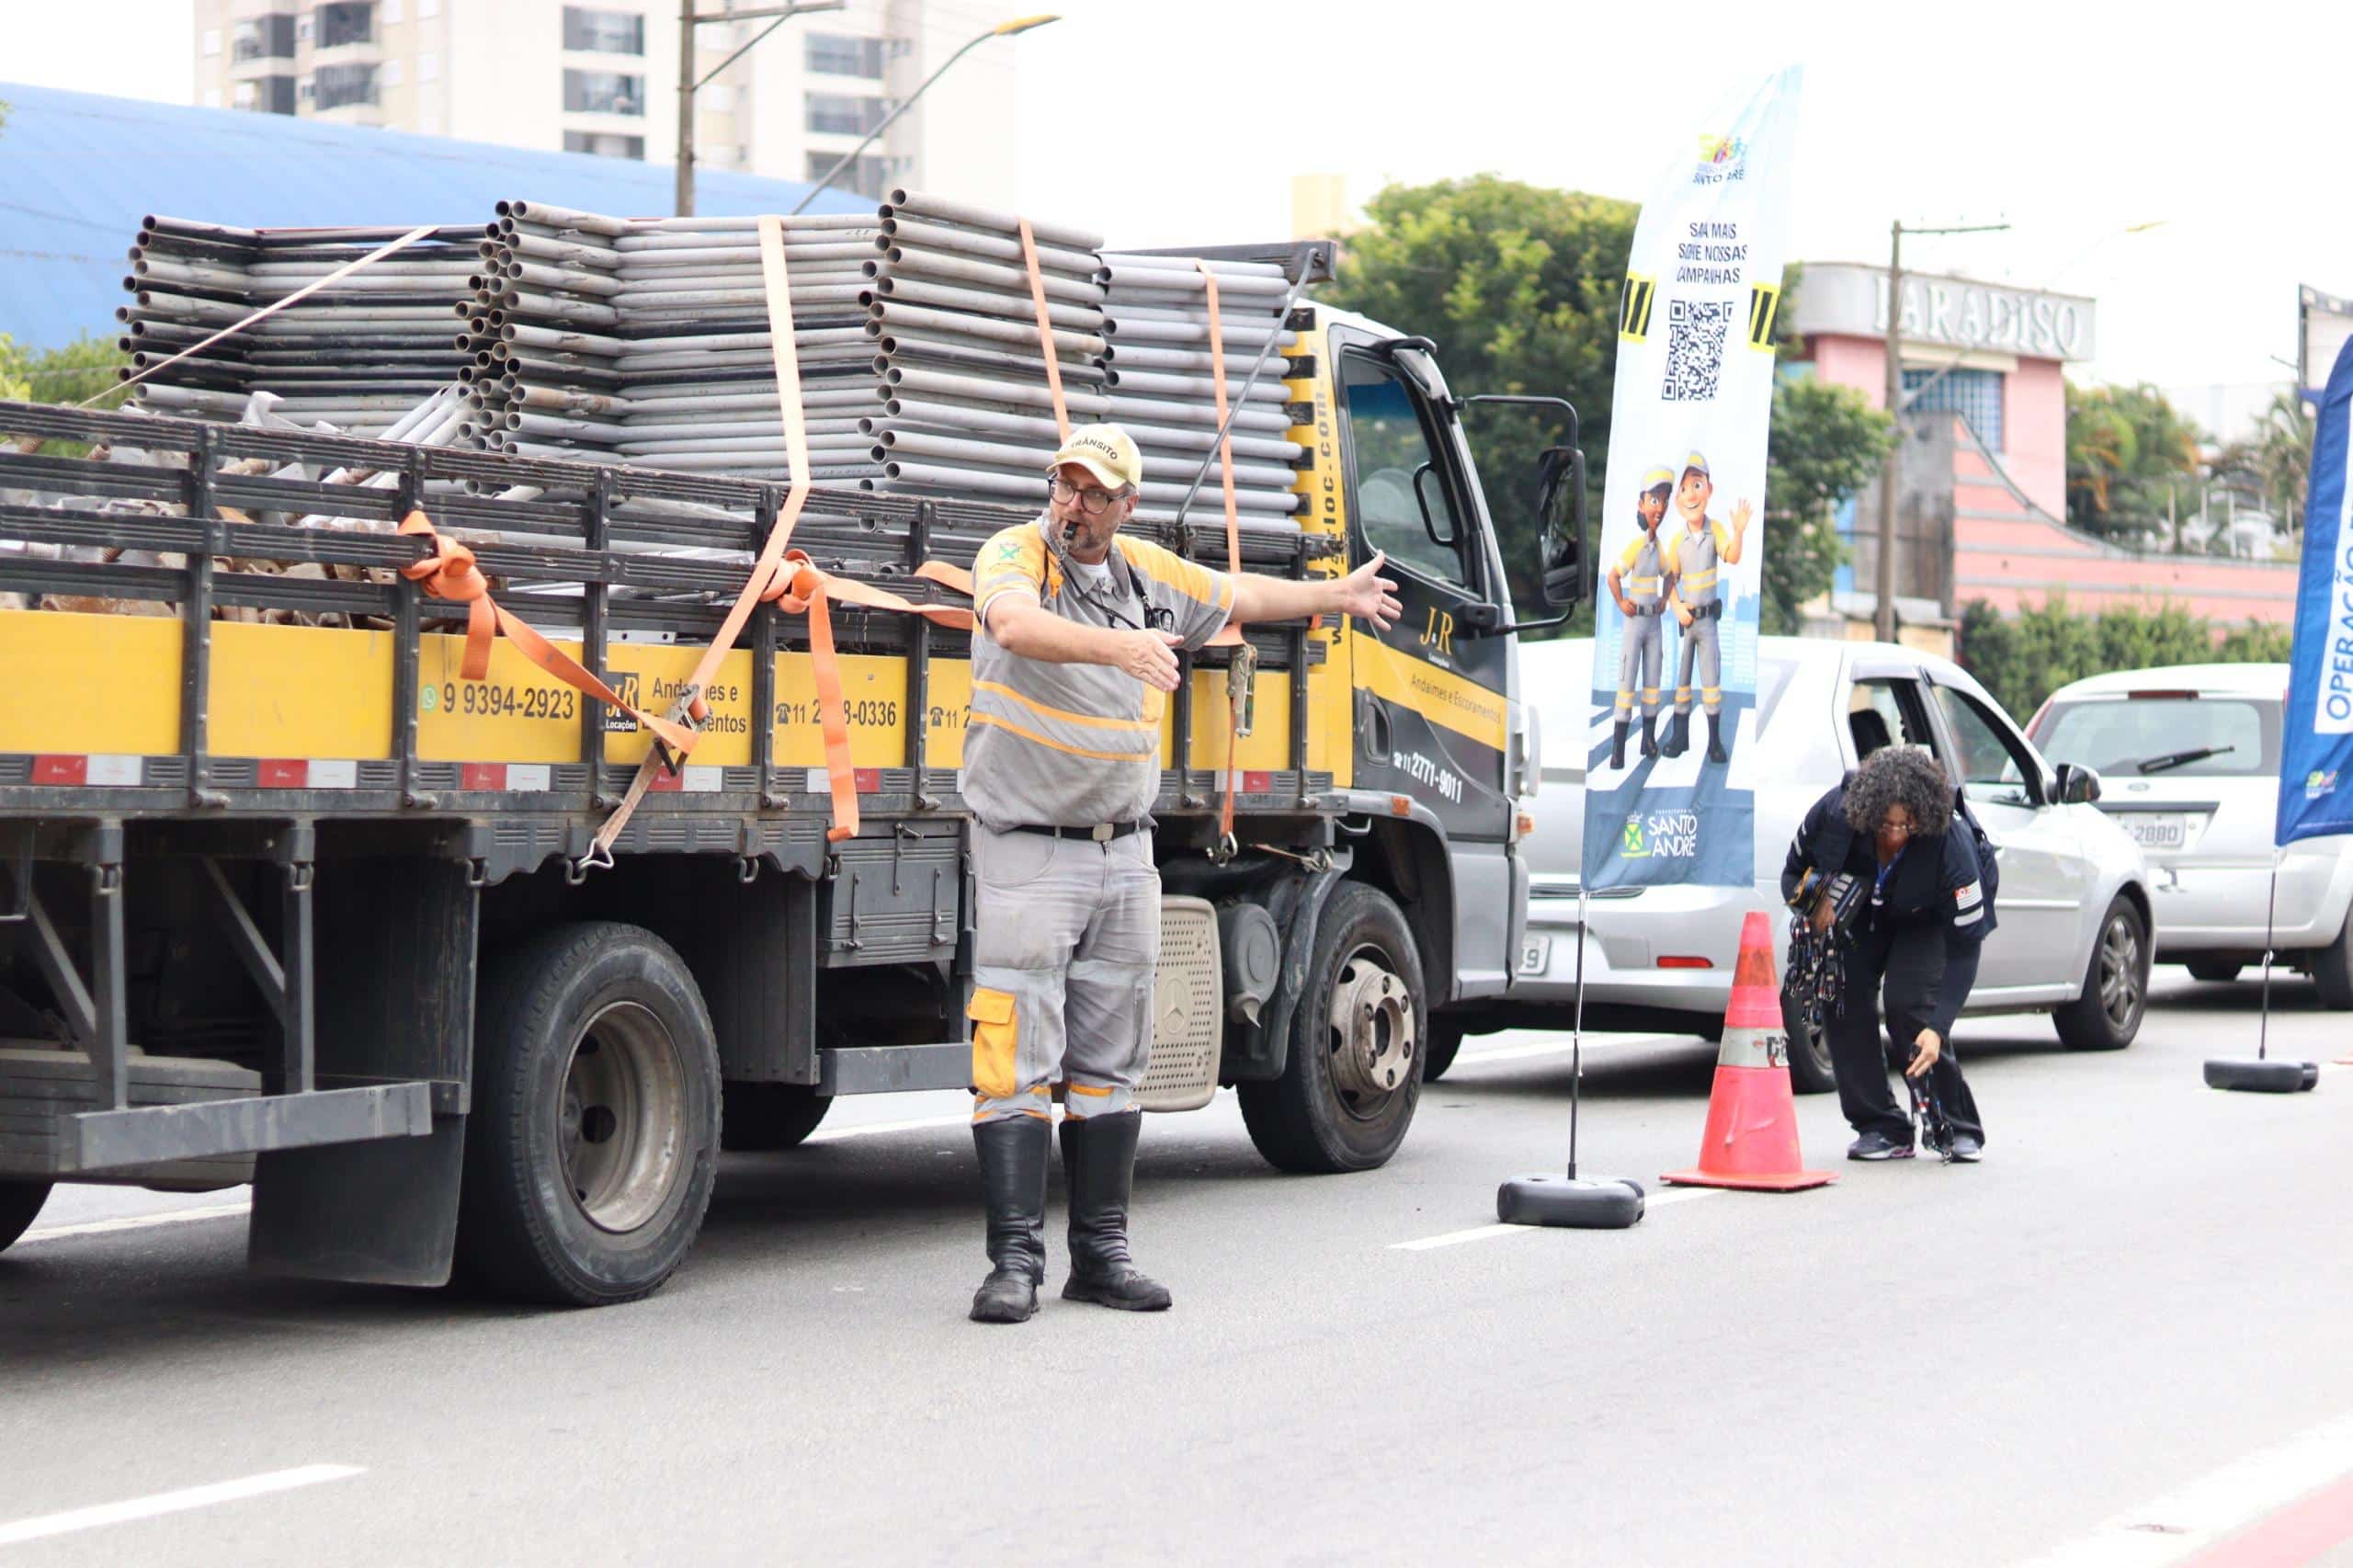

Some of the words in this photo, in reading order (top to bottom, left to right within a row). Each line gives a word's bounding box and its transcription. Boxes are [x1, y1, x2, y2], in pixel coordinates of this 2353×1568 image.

[653, 676, 726, 701] Andes
[730, 687, 738, 701] e
[443, 682, 456, 713] 9
[463, 683, 574, 720] 9394-2923
[793, 703, 805, 724] 11
[812, 699, 897, 727] 28-0336
[947, 710, 958, 729] 11
[1648, 814, 1699, 835] SANTO
[1653, 834, 1697, 858] ANDRÉ
